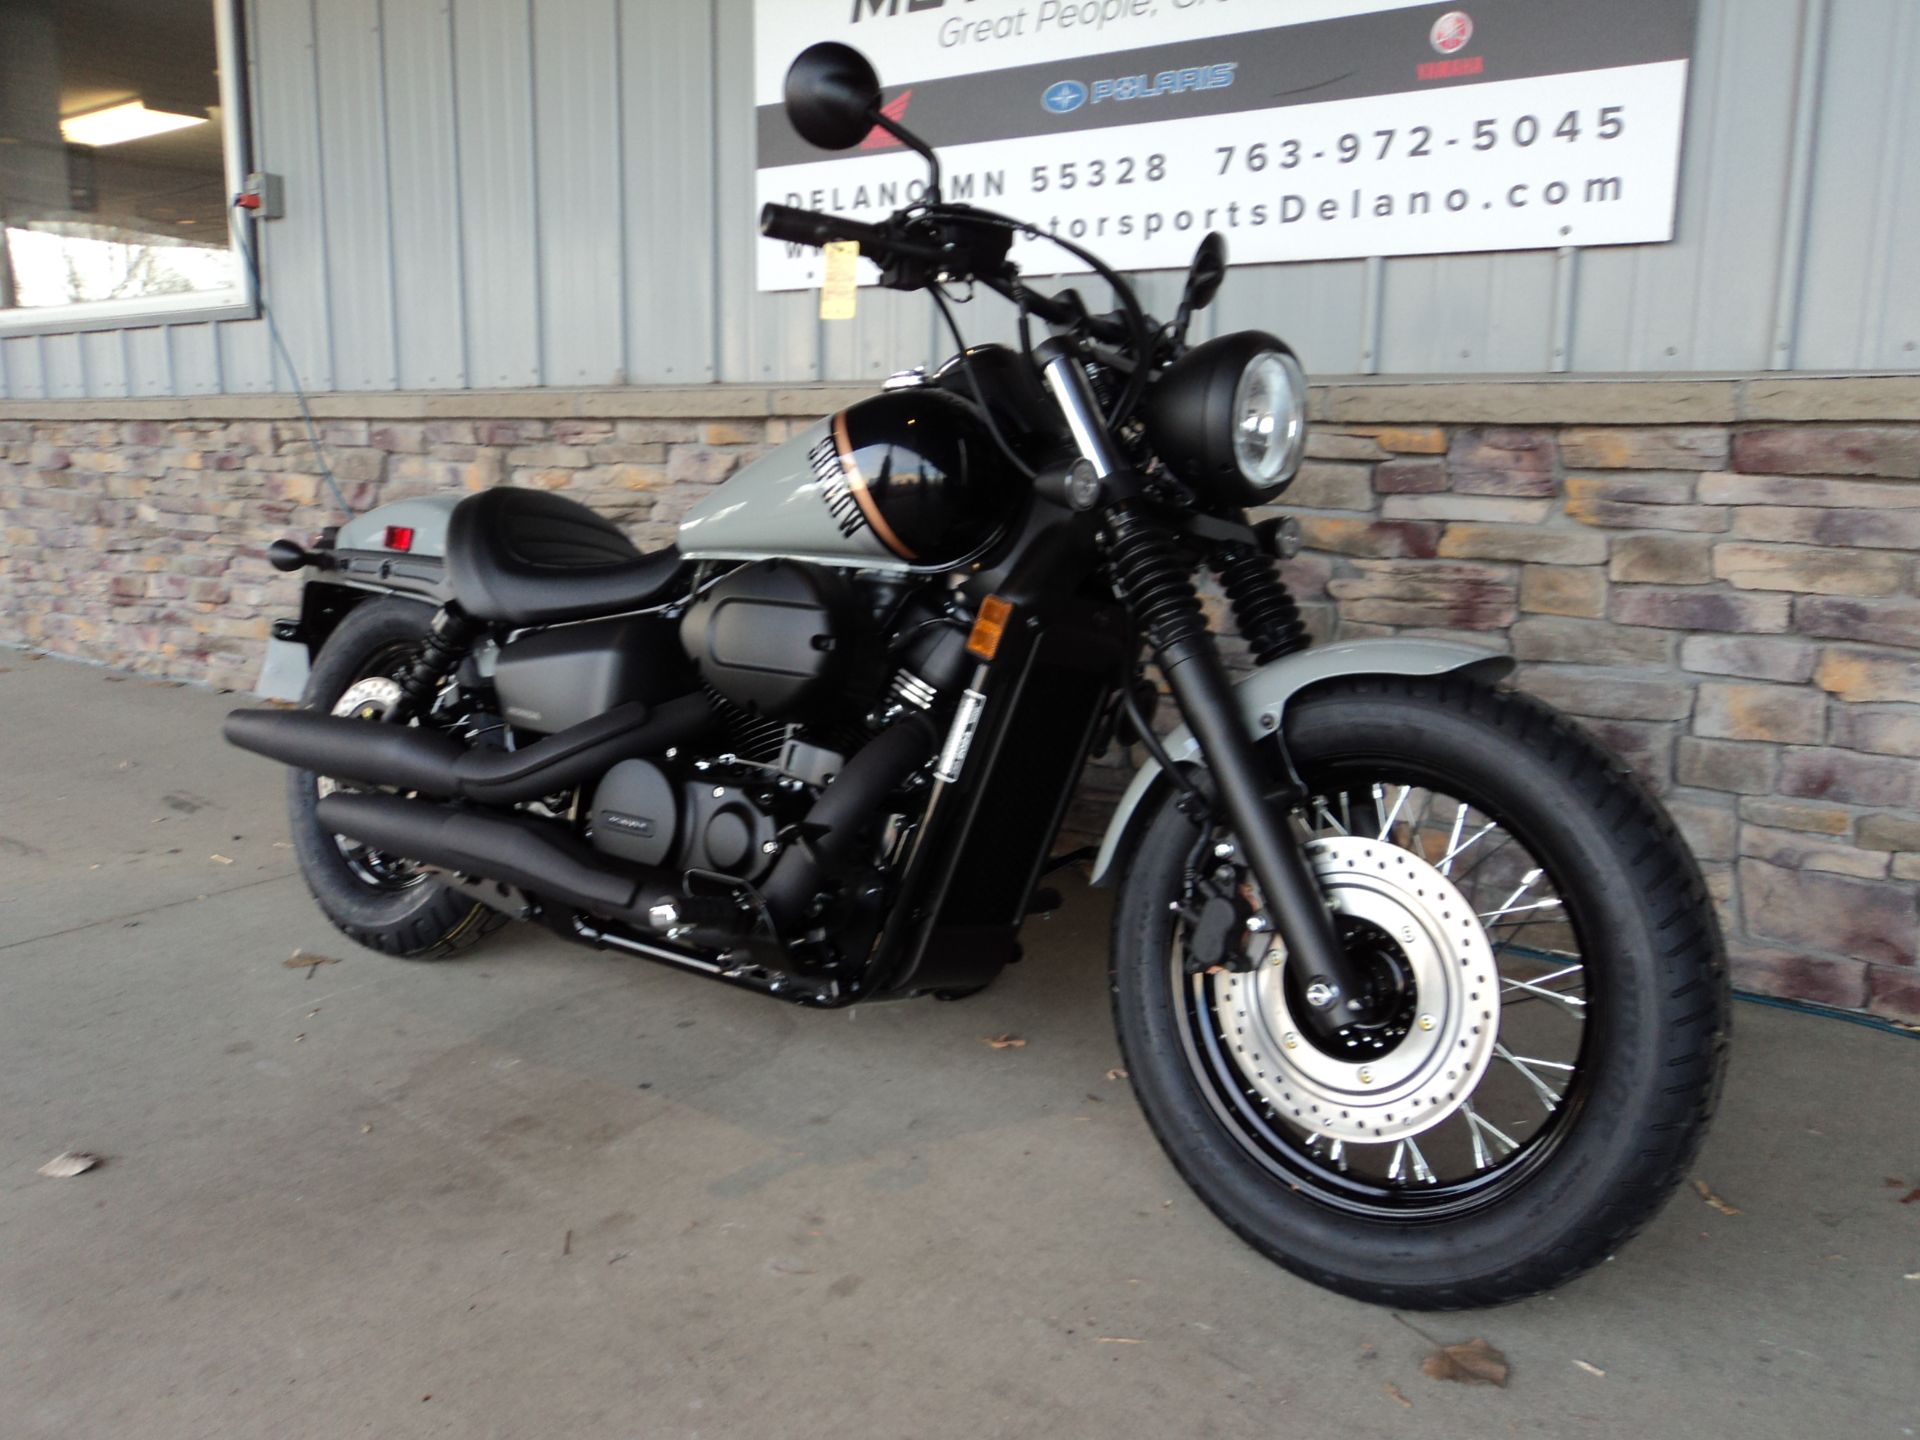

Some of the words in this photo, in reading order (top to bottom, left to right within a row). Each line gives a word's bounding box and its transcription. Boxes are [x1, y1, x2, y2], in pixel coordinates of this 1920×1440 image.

[938, 8, 1029, 48] Great
[1090, 62, 1238, 104] POLARIS
[951, 169, 1006, 201] MN
[1031, 152, 1167, 193] 55328
[1215, 105, 1626, 175] 763-972-5045
